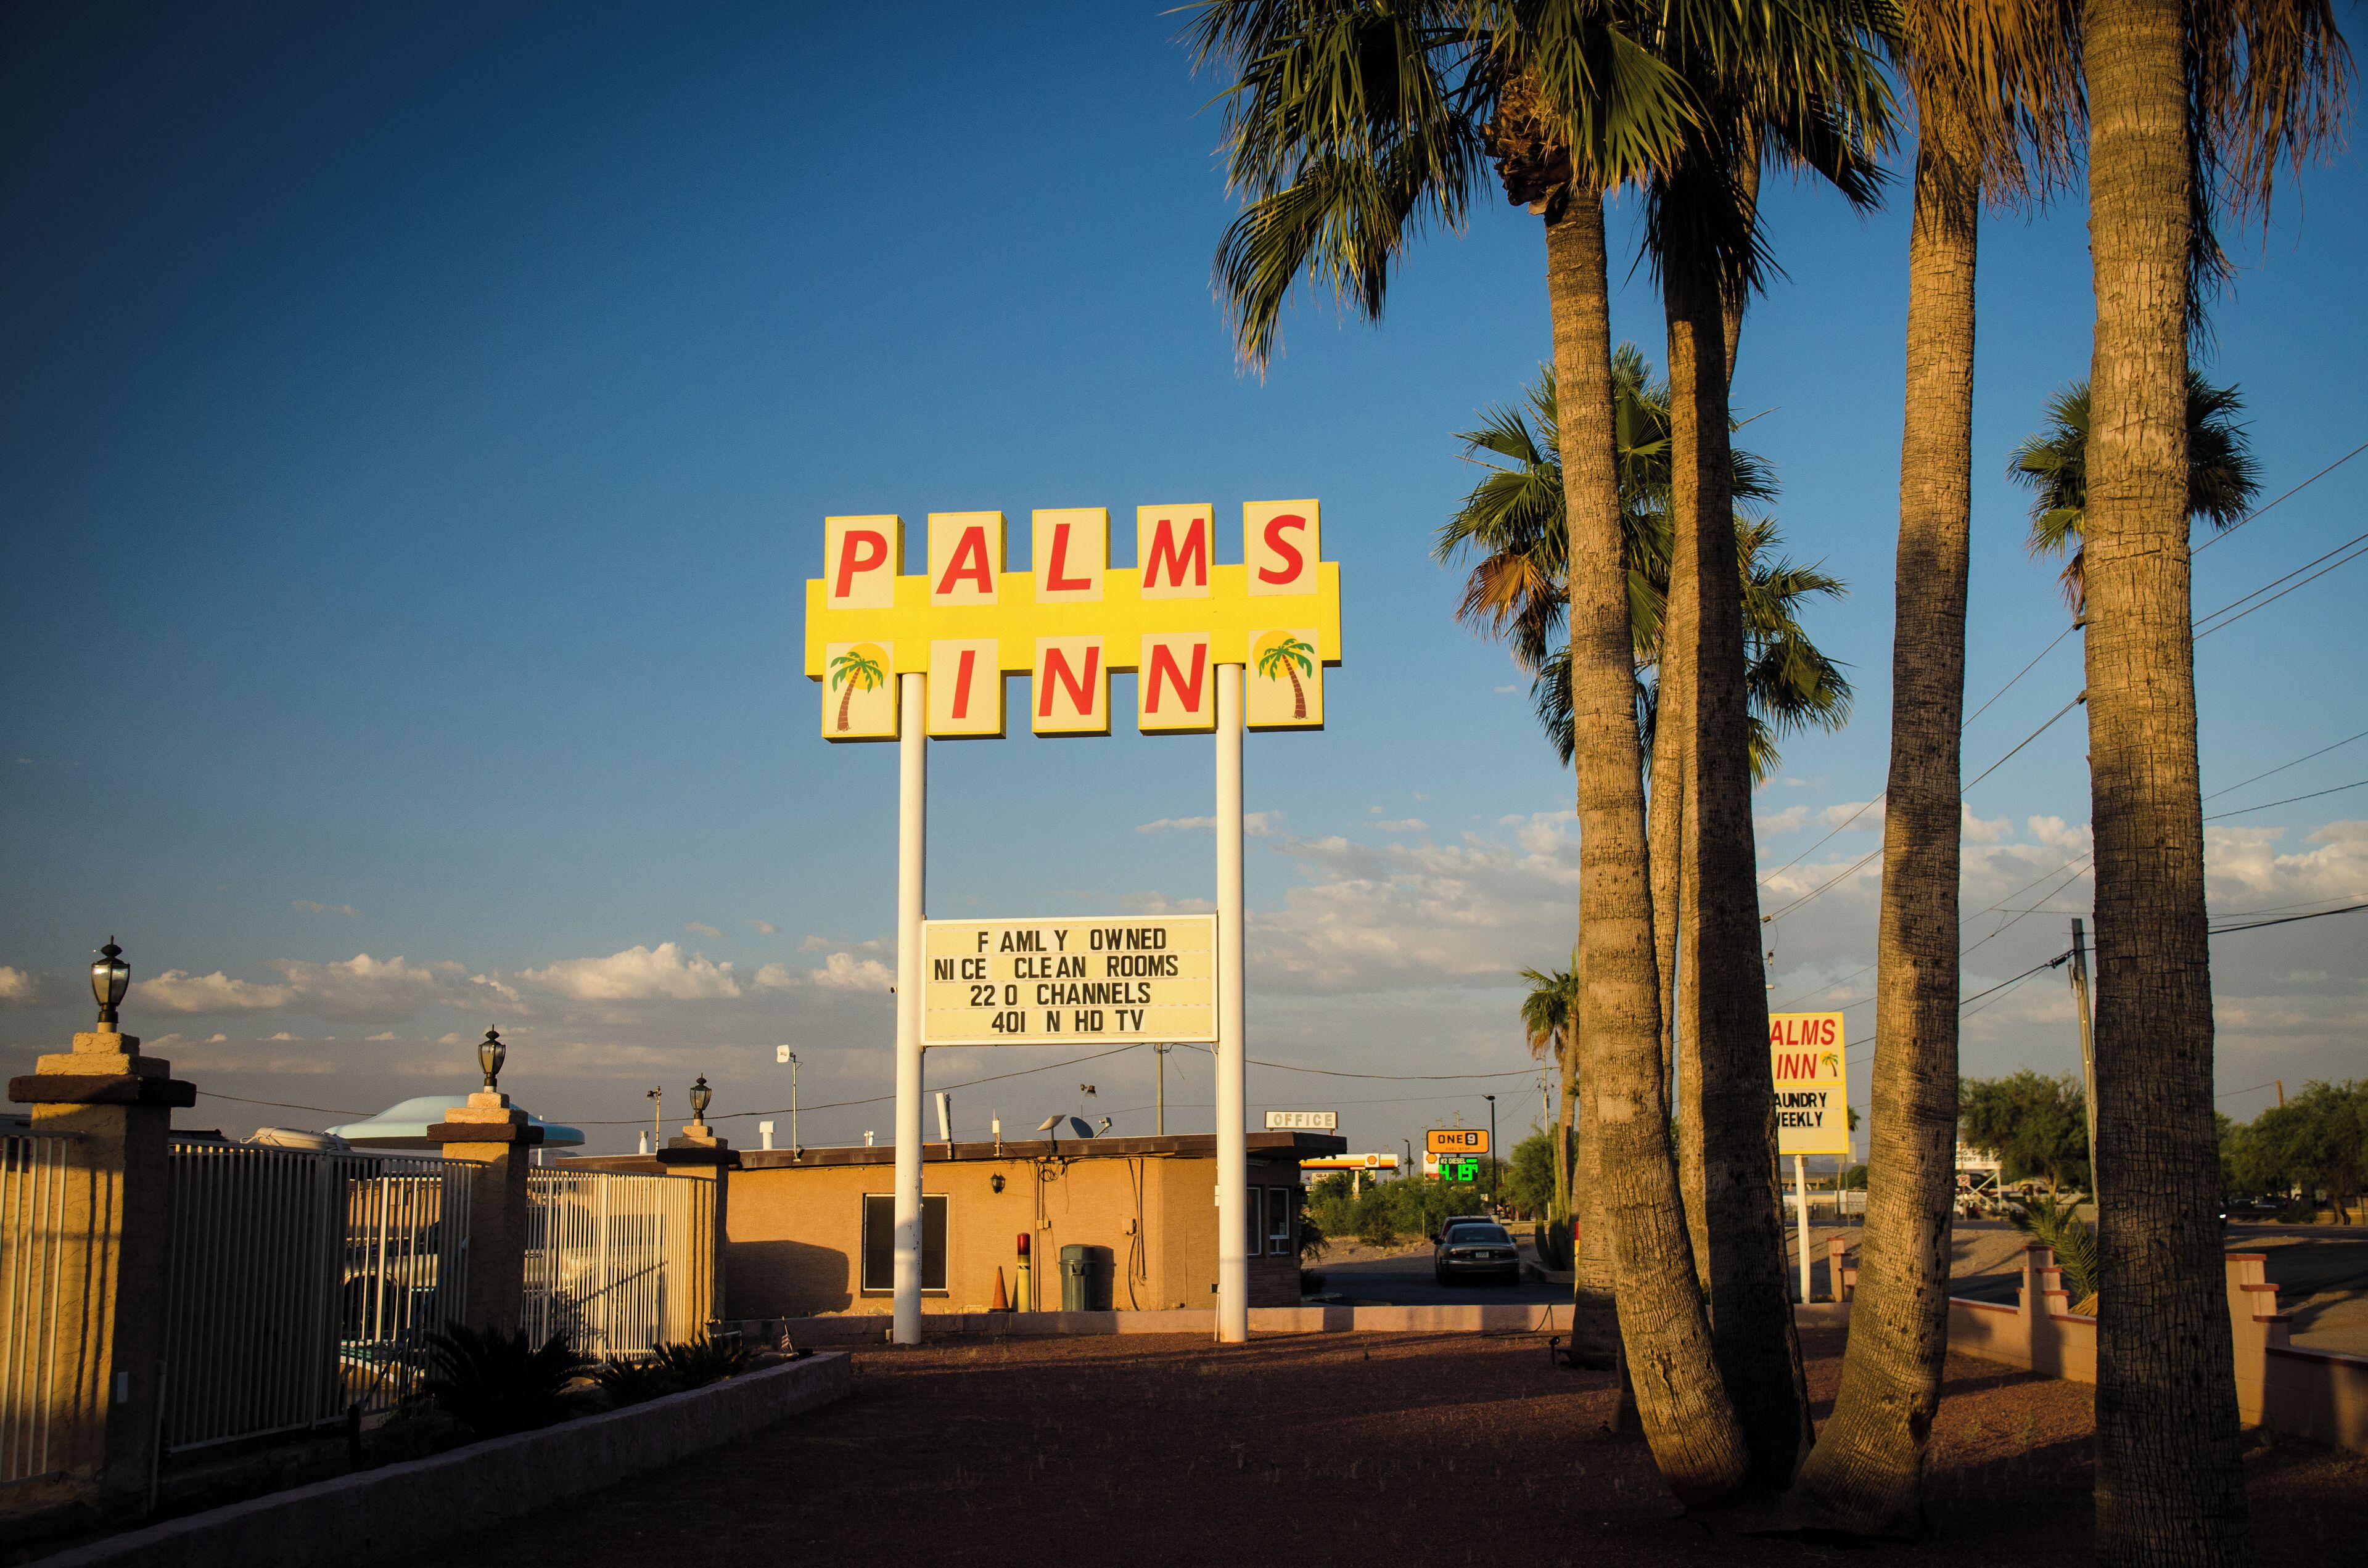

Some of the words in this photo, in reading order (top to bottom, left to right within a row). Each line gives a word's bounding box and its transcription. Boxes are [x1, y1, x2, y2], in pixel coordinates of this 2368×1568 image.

[834, 514, 1307, 597] PALMS
[952, 643, 1207, 719] INN
[1090, 928, 1167, 950] OWNED
[934, 958, 987, 980] NICE
[1014, 956, 1086, 979] CLEAN
[1107, 954, 1178, 977] ROOMS
[1037, 982, 1151, 1005] CHANNELS
[1075, 1010, 1103, 1032] HD
[1115, 1009, 1144, 1032] TV
[1770, 1019, 1835, 1046] ALMS
[1776, 1053, 1817, 1079] INN
[1775, 1092, 1827, 1108] AUNDRY
[1273, 1113, 1333, 1127] OFFICE
